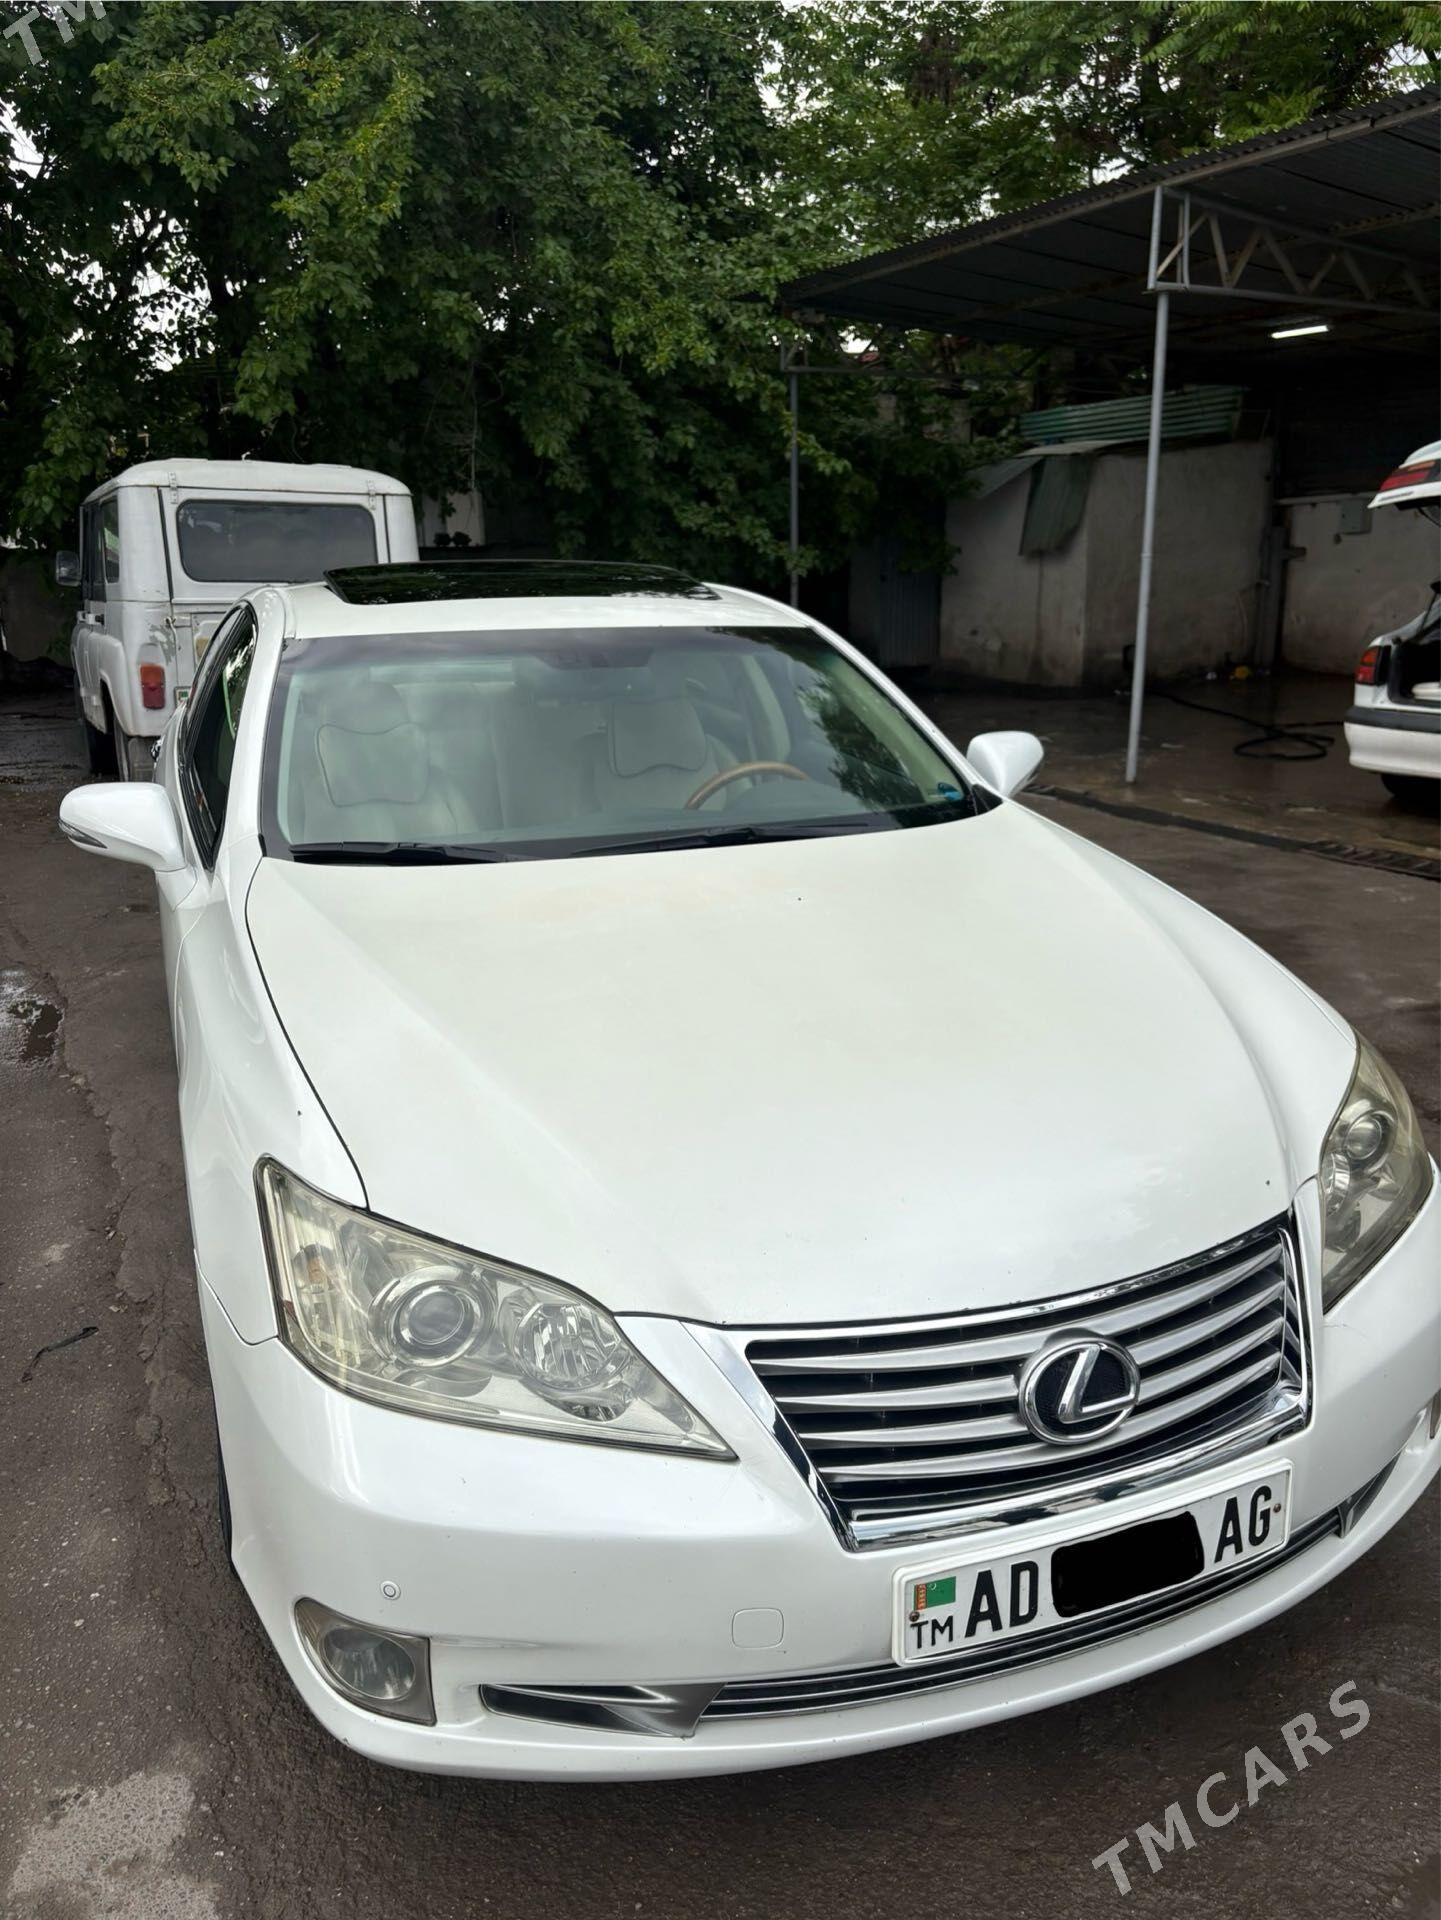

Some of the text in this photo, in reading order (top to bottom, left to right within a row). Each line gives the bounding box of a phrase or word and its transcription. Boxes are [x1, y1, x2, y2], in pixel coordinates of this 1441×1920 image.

[964, 1485, 1272, 1638] AD AG
[910, 1616, 954, 1649] TM
